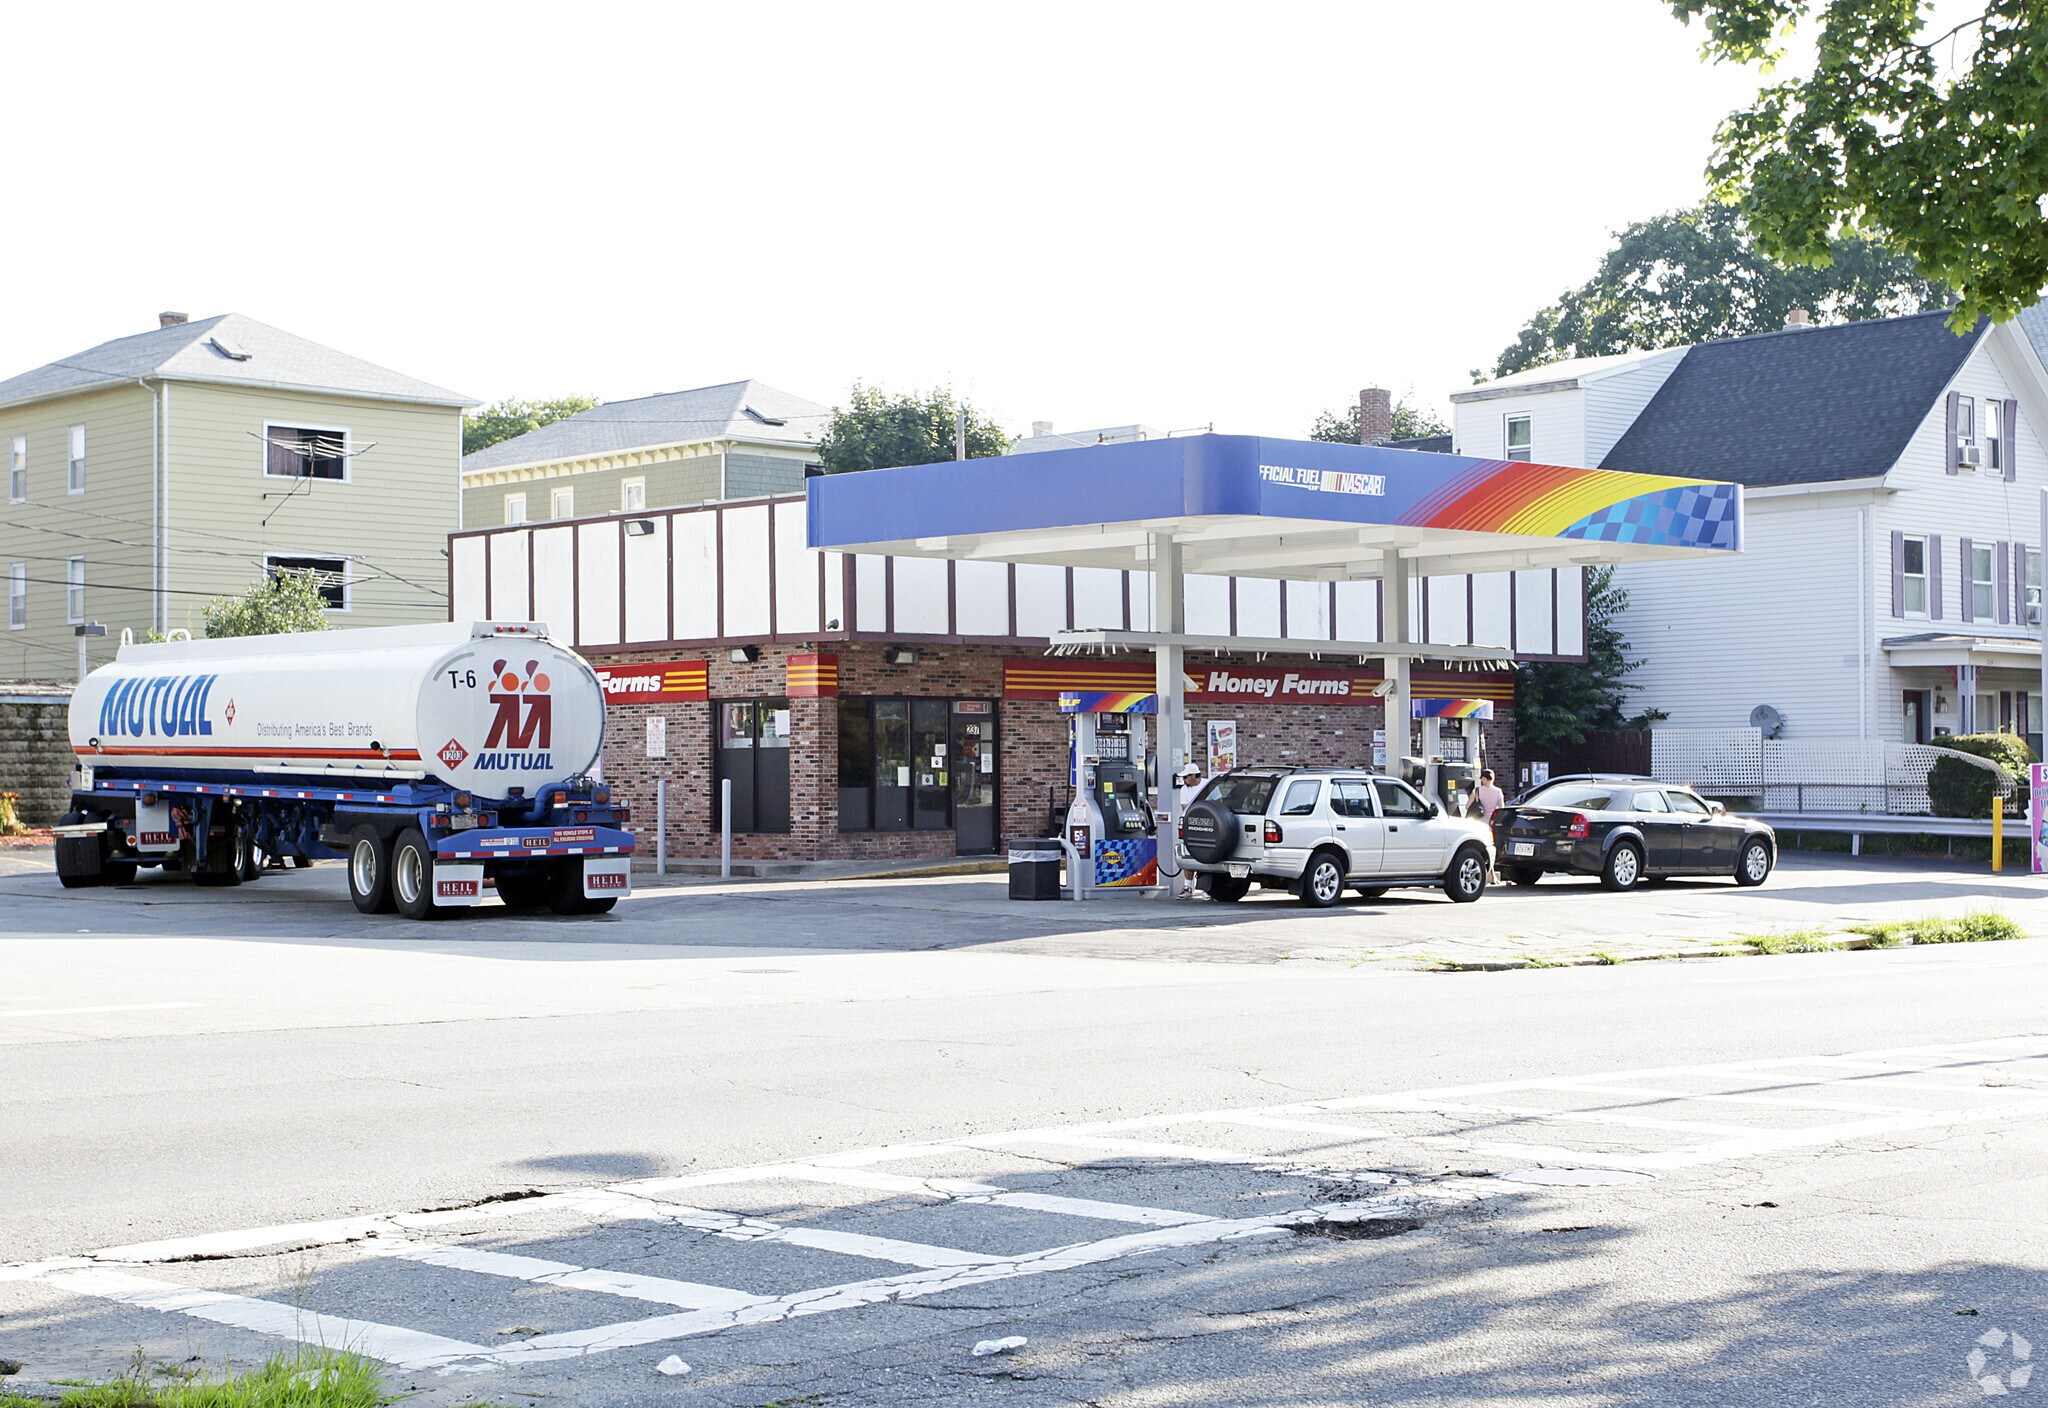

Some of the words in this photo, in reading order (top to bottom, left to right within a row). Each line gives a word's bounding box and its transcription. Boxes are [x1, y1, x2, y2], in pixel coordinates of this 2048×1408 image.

[1295, 468, 1320, 485] FUEL
[1341, 474, 1384, 496] NASCAR
[448, 669, 476, 689] T-6
[596, 671, 661, 694] Farms
[1207, 671, 1279, 697] Honey
[1282, 673, 1349, 695] Farms
[99, 674, 219, 737] MUTUAL
[257, 722, 292, 740] Distributing
[295, 722, 327, 737] America's
[329, 722, 344, 737] Best
[348, 722, 372, 737] Brands
[443, 751, 462, 760] 1203
[473, 753, 554, 770] MUTUAL
[1188, 817, 1214, 827] ISUZU
[442, 882, 473, 892] HEIL
[592, 875, 622, 885] HEIL
